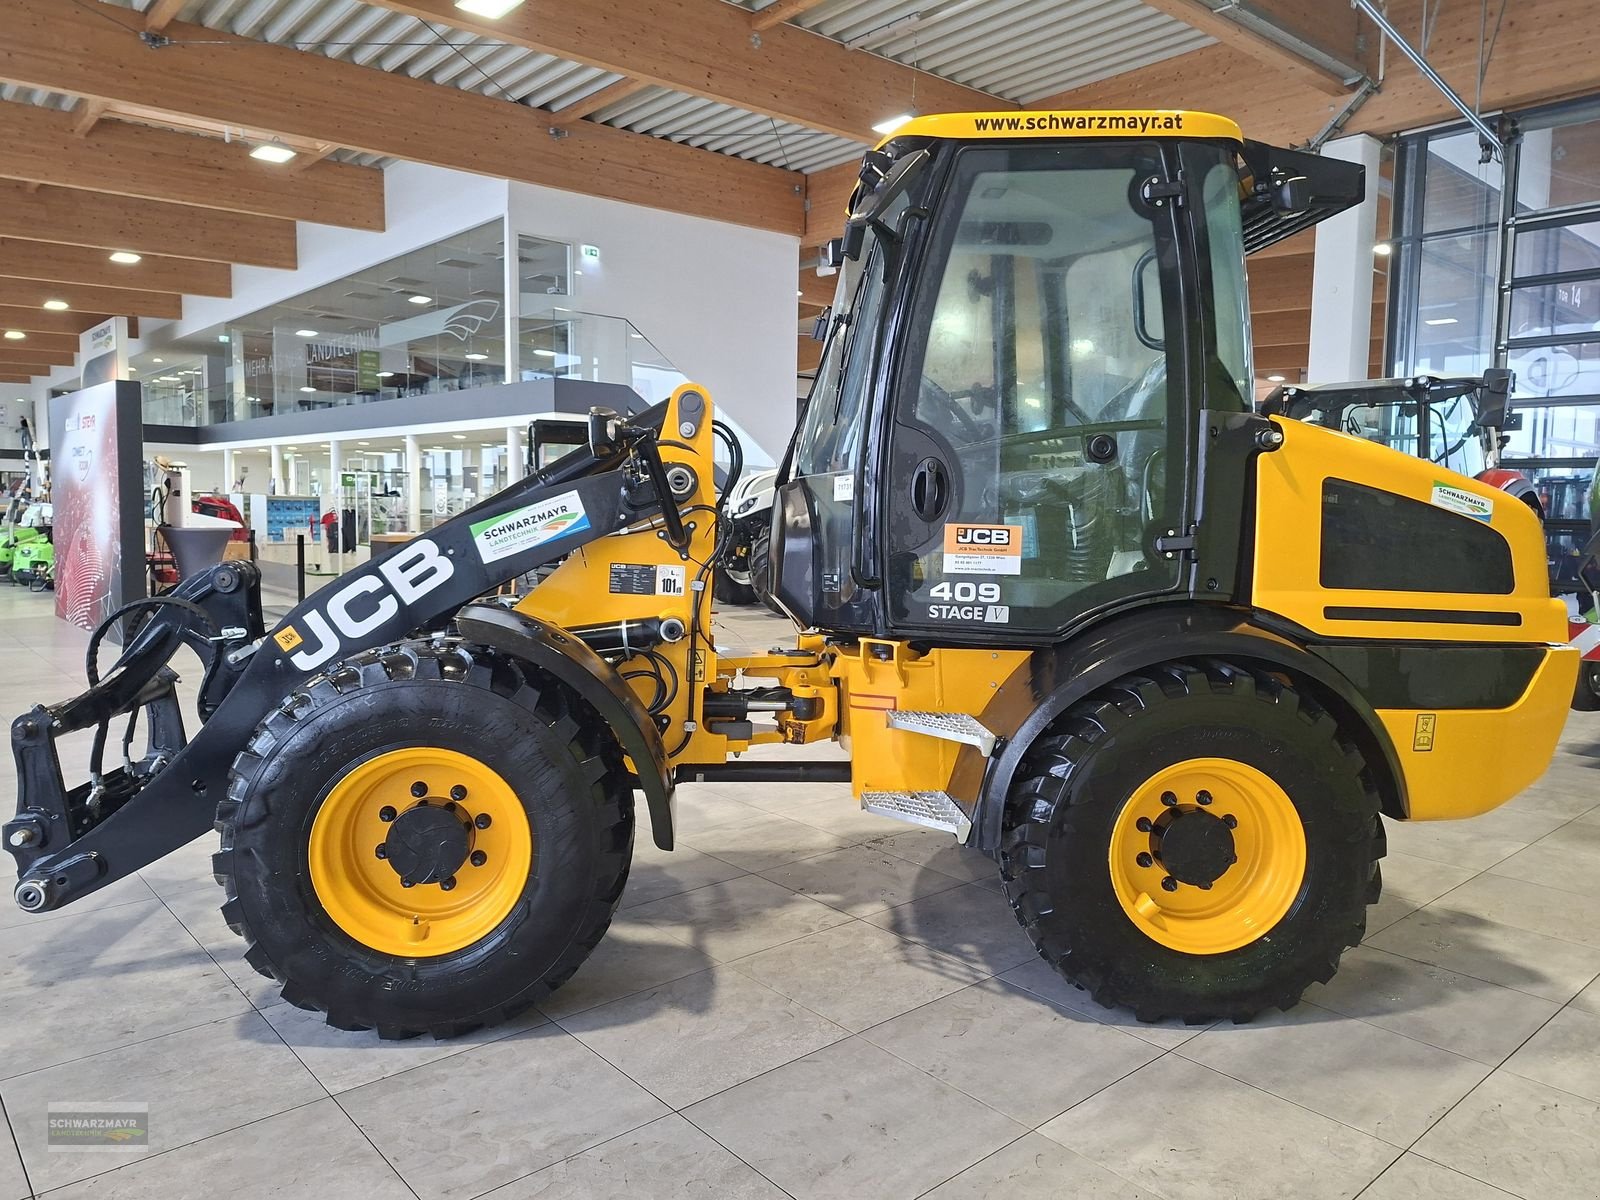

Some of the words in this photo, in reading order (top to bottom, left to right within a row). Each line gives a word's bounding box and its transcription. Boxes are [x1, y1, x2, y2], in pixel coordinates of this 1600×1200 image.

[975, 113, 1183, 133] www.schwarzmayr.at
[1571, 285, 1581, 308] 14
[306, 328, 377, 364] LANDTECHNIK
[1439, 488, 1485, 507] SCHWARZMAYR
[484, 505, 569, 541] SCHWARZMAYR
[489, 526, 540, 548] LANDTECHNIK
[957, 529, 1010, 545] JCB
[662, 578, 677, 593] 101
[929, 582, 1001, 603] 409
[290, 539, 455, 672] JCB
[928, 605, 984, 620] STAGE
[992, 607, 1004, 621] V
